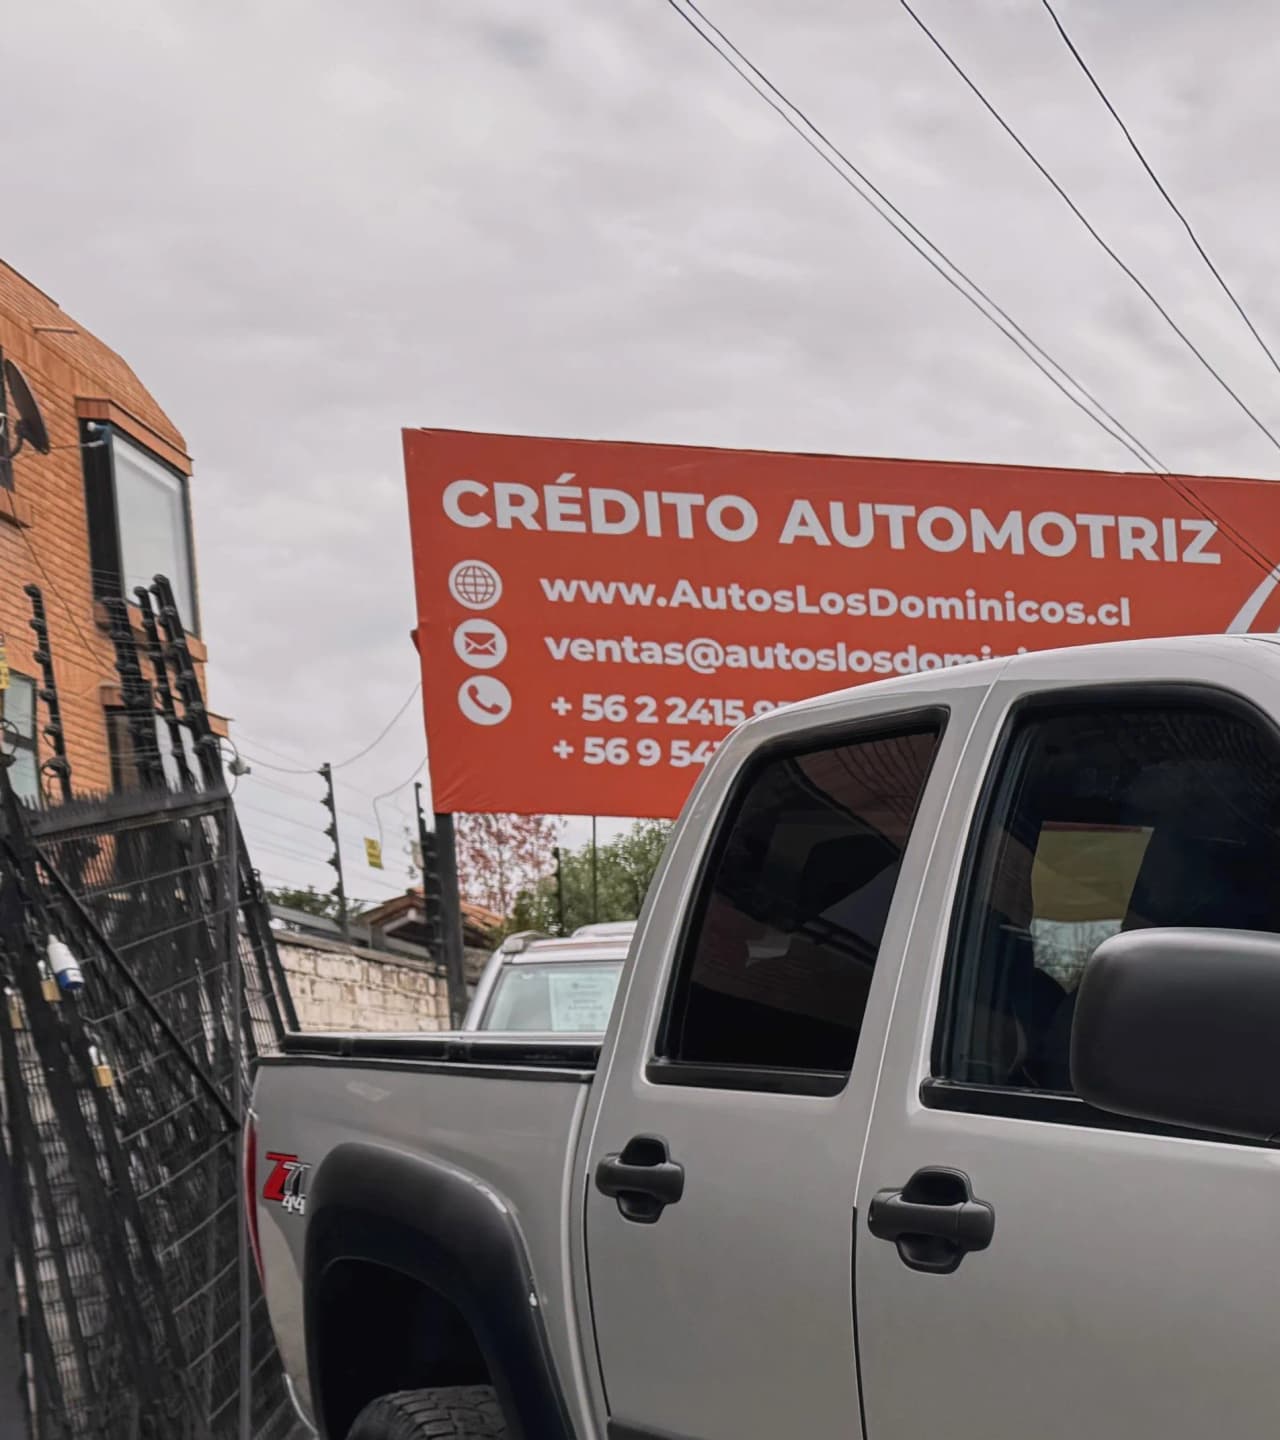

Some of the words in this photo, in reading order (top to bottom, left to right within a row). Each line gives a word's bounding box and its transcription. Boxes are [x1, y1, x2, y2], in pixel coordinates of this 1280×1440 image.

[442, 472, 759, 543] CRÉDITO
[779, 499, 1222, 565] AUTOMOTRIZ
[539, 577, 1131, 627] www.AutosLosDominicos.cl
[582, 694, 628, 722] 56
[636, 697, 659, 724] 2
[665, 697, 746, 727] 2415
[583, 737, 630, 766] 56
[637, 738, 661, 767] 9
[669, 739, 722, 768] 54
